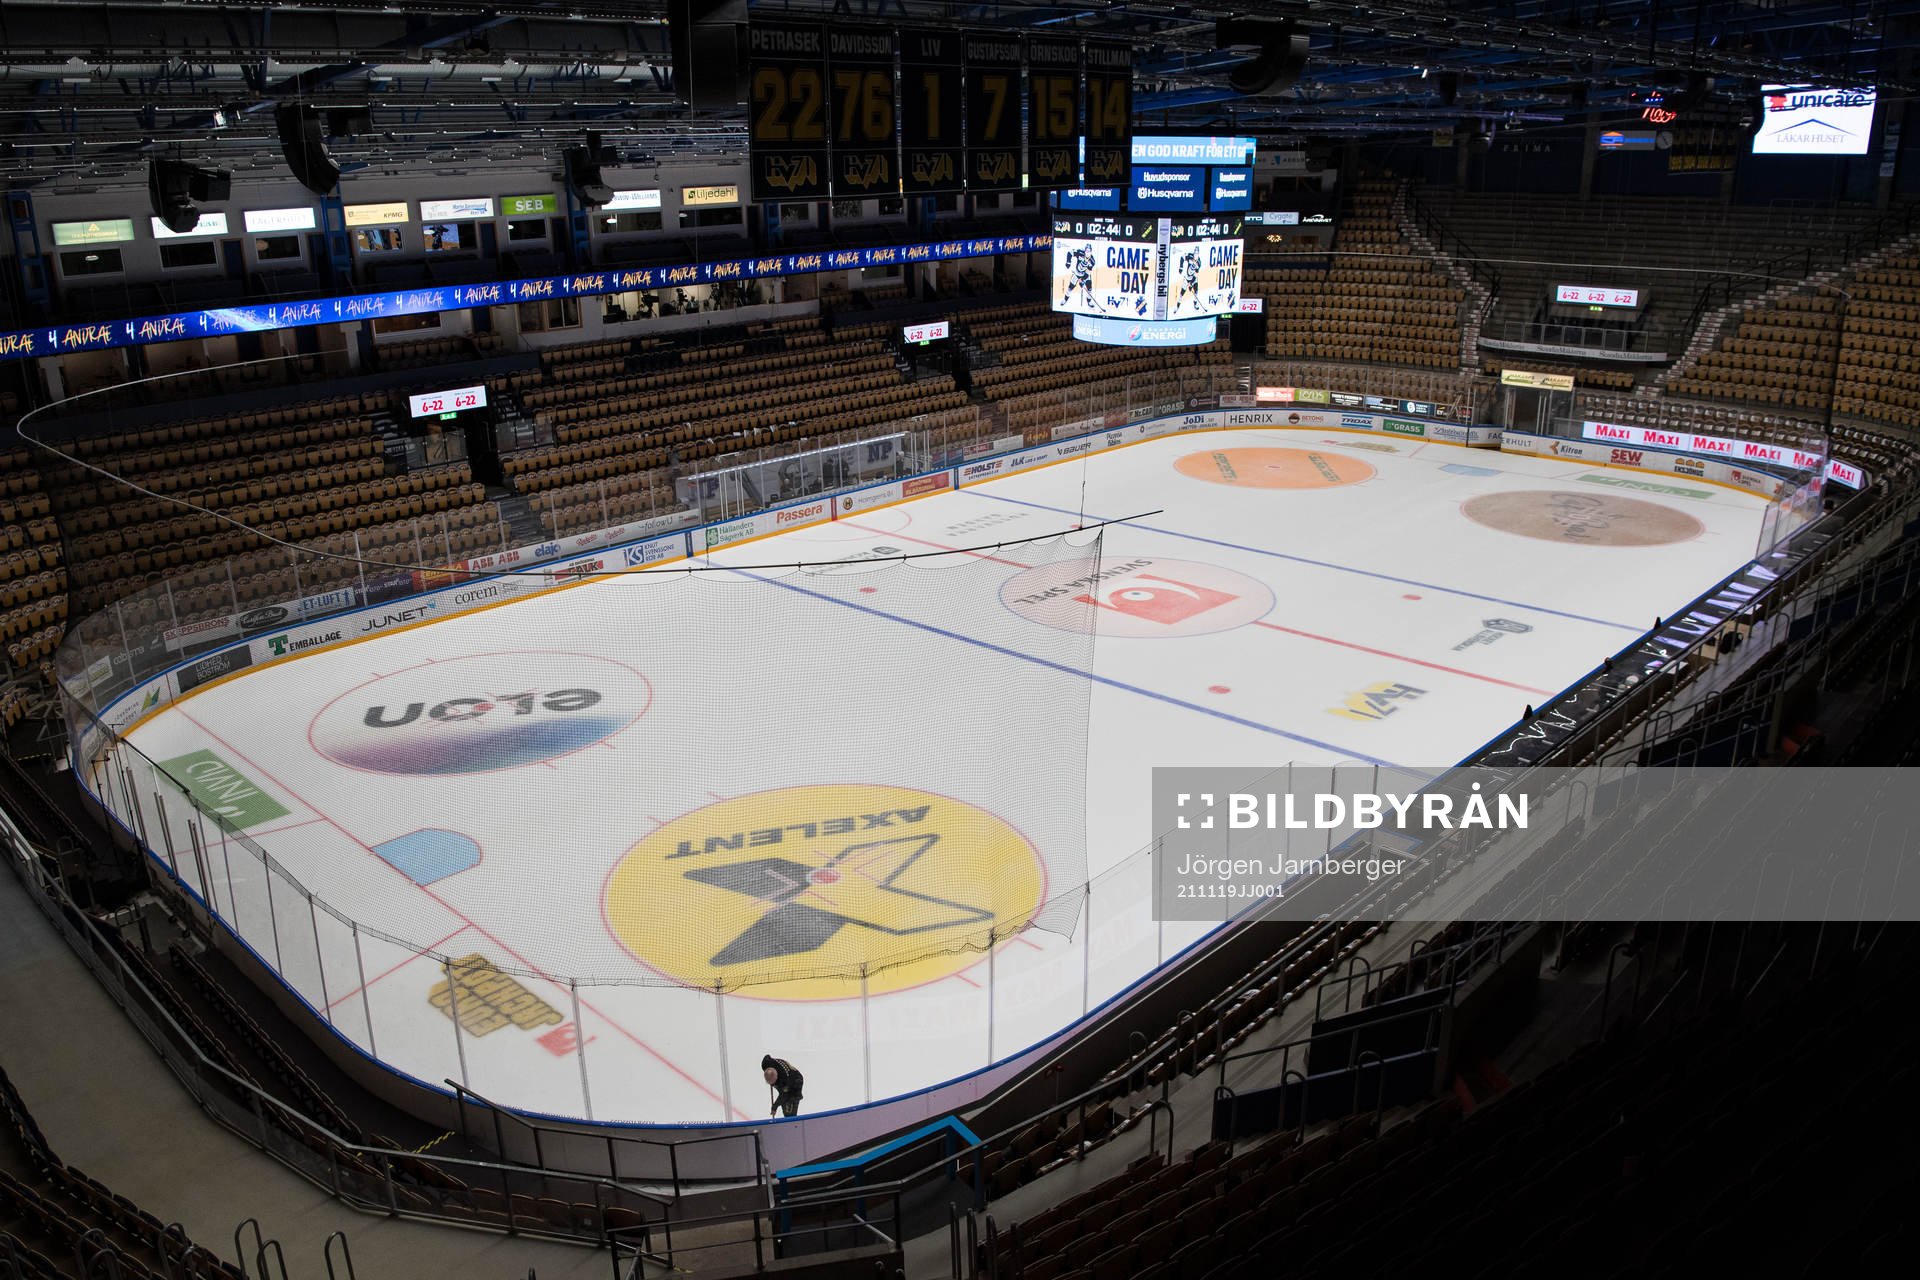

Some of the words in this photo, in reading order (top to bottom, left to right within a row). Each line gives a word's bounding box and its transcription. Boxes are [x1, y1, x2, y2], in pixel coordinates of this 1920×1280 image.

[751, 29, 820, 52] PETRASEK
[831, 33, 892, 56] DAVIDSSON
[921, 38, 941, 57] LIV
[968, 40, 1021, 62] GUSTAFSSON
[1030, 38, 1077, 63] ÖRNSKOG
[1087, 48, 1131, 67] STILLMAN
[752, 67, 826, 142] 22
[834, 69, 894, 142] 76
[923, 72, 940, 141] 1
[982, 75, 1008, 141] 7
[1033, 76, 1076, 140] 15
[1089, 78, 1126, 139] 14
[1791, 94, 1865, 108] unicare
[1777, 134, 1845, 144] LÄKARHUSET
[1132, 144, 1146, 157] EN
[1147, 144, 1170, 157] GOD
[1172, 144, 1206, 157] KRAFT
[1074, 189, 1112, 198] Husqvarna
[1147, 188, 1194, 199] Husqvarna
[383, 211, 403, 219] KPMG
[515, 200, 544, 212] SEB
[1075, 222, 1083, 234] 0
[1089, 223, 1119, 236] 02:44
[1125, 225, 1133, 236] 0
[1107, 246, 1150, 271] GAME
[1157, 243, 1167, 284] nybergs
[1210, 245, 1239, 267] GAME
[1120, 272, 1149, 294] DAY
[1218, 268, 1238, 290] DAY
[48, 329, 58, 348] 4
[126, 321, 135, 340] 4
[199, 314, 208, 331] 4
[269, 306, 277, 323] 4
[334, 300, 342, 317] 4
[396, 294, 403, 310] 4
[454, 288, 461, 303] 4
[510, 284, 517, 298] 4
[563, 278, 569, 292] 4
[612, 273, 619, 288] 4
[660, 268, 666, 283] 4
[705, 264, 711, 279] 4
[748, 260, 754, 275] 4
[789, 256, 795, 270] 4
[828, 253, 834, 267] 4
[866, 250, 871, 264] 4
[1157, 285, 1167, 298] bil
[1562, 291, 1579, 300] 6-22
[1588, 293, 1605, 302] 6-22
[1614, 295, 1632, 304] 6-22
[1241, 303, 1258, 311] 6-22
[422, 399, 444, 413] 6-22
[455, 394, 477, 408] 6-22
[1183, 414, 1205, 425] JoDi
[1229, 413, 1273, 424] HENRIX
[1063, 442, 1092, 455] BAUER
[1560, 445, 1583, 455] Kitron
[1611, 448, 1644, 463] SEW
[971, 461, 996, 474] HOLST
[1011, 456, 1025, 467] JLK
[776, 504, 823, 524] Passera
[719, 521, 754, 534] Hållanders
[720, 531, 744, 543] Sågverk
[745, 528, 754, 537] AB
[535, 542, 561, 557] elajo
[644, 541, 658, 550] KNUT
[472, 556, 494, 571] ABB
[499, 550, 520, 564] ABB
[628, 545, 645, 566] KS
[1064, 558, 1153, 588] SVENSKA
[454, 585, 499, 605] corem
[1012, 586, 1068, 605] SPEL
[362, 605, 429, 632] JUNET
[165, 617, 230, 641] SKPPSBRONS
[268, 634, 289, 656] T
[289, 630, 342, 652] EMBALLAGE
[665, 805, 931, 859] AXELENT
